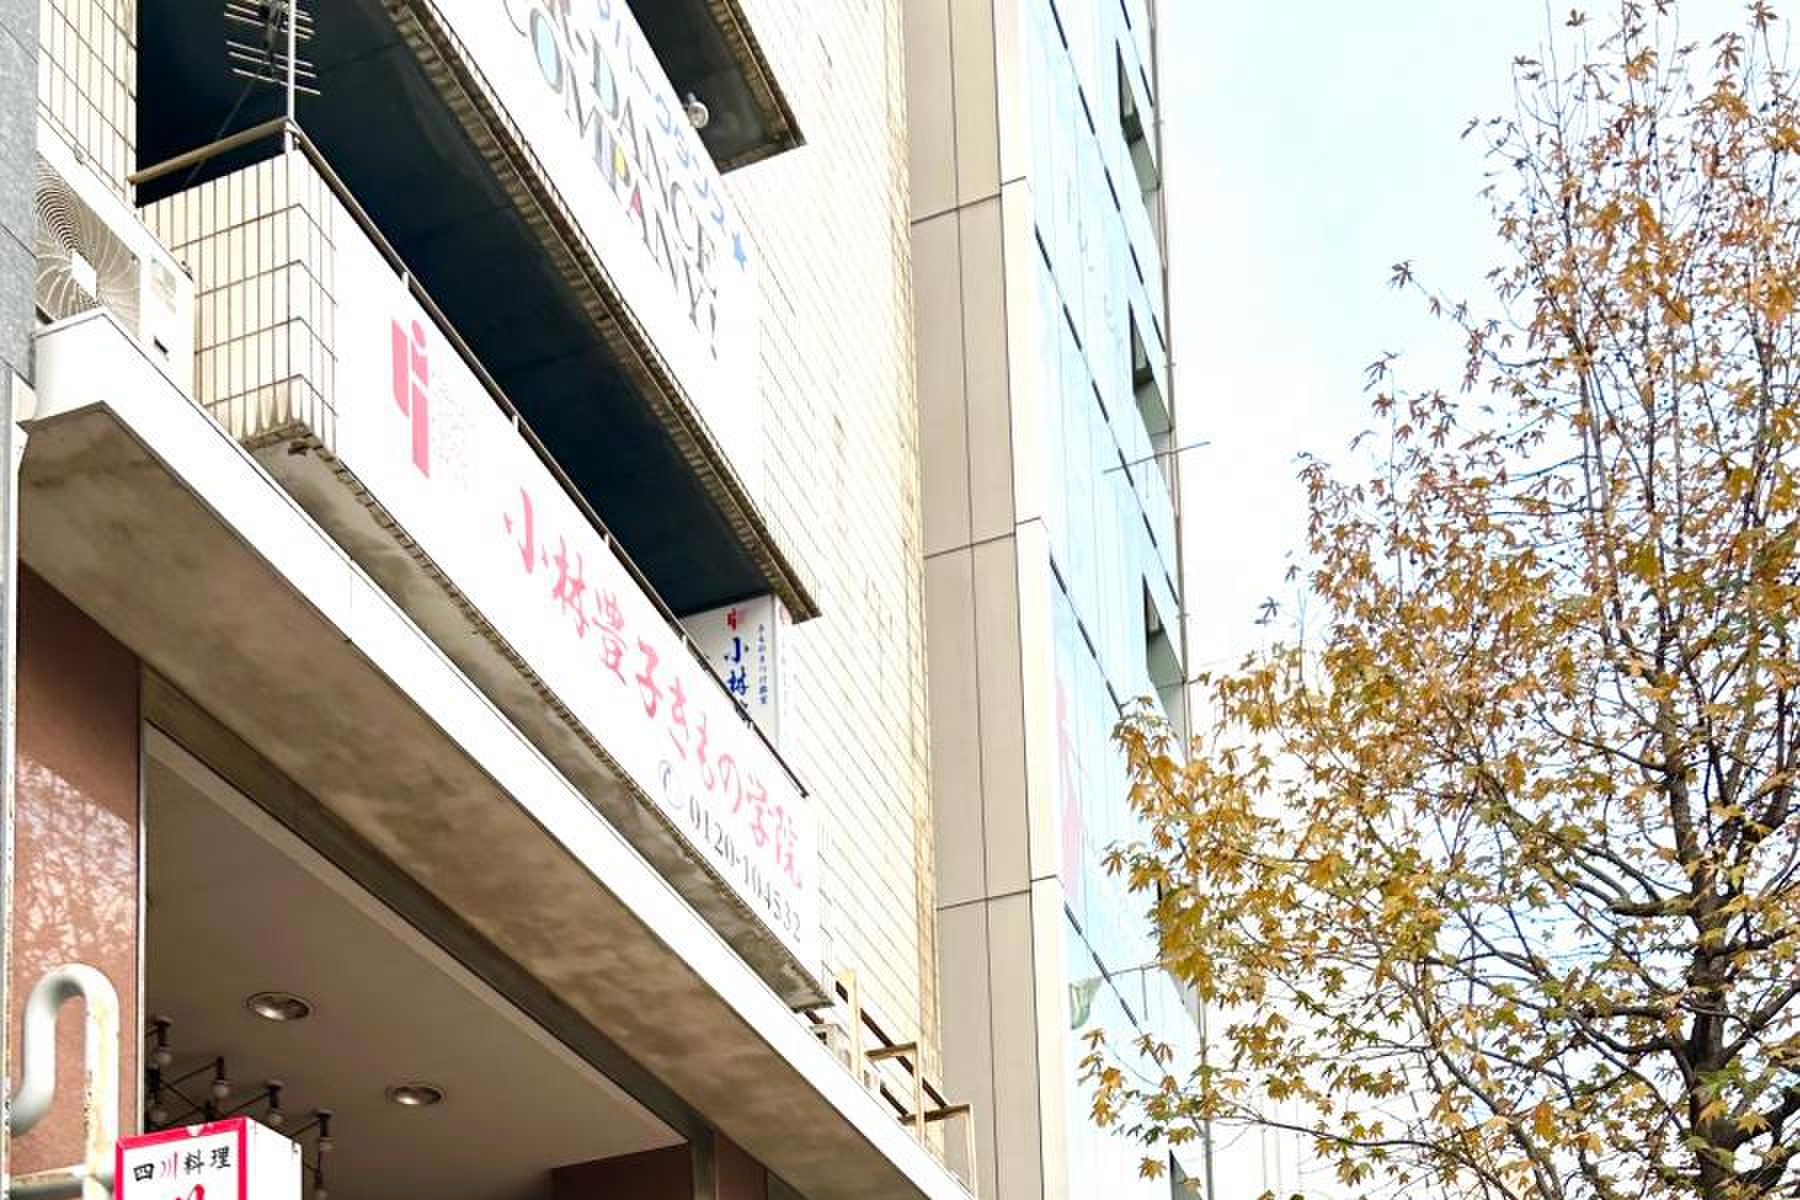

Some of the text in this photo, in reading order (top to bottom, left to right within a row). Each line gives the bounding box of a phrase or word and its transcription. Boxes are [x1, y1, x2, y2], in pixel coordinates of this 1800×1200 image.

[504, 0, 717, 360] OMPANY!
[132, 1145, 232, 1182] 四川料理
